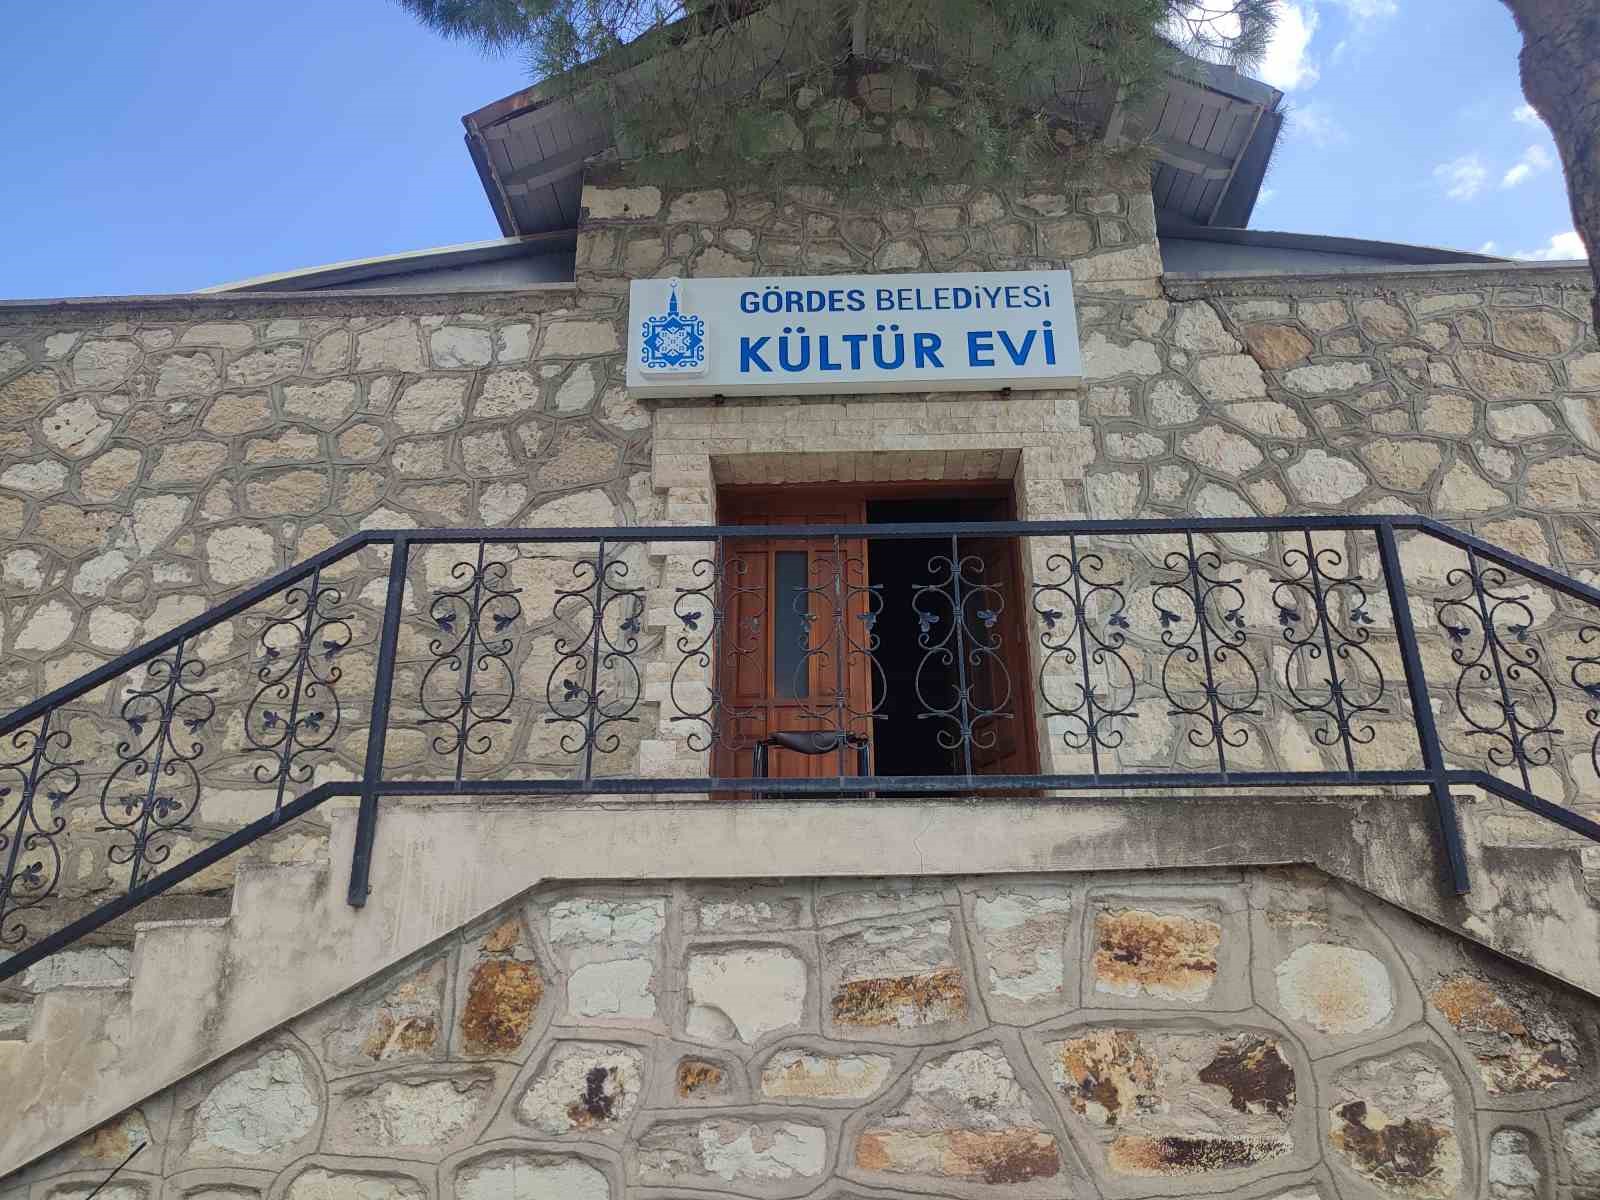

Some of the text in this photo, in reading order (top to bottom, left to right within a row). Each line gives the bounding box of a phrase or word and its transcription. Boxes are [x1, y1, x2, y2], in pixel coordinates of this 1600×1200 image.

[740, 286, 866, 314] GÖRDES
[740, 320, 1057, 373] KÜLTÜR EVİ
